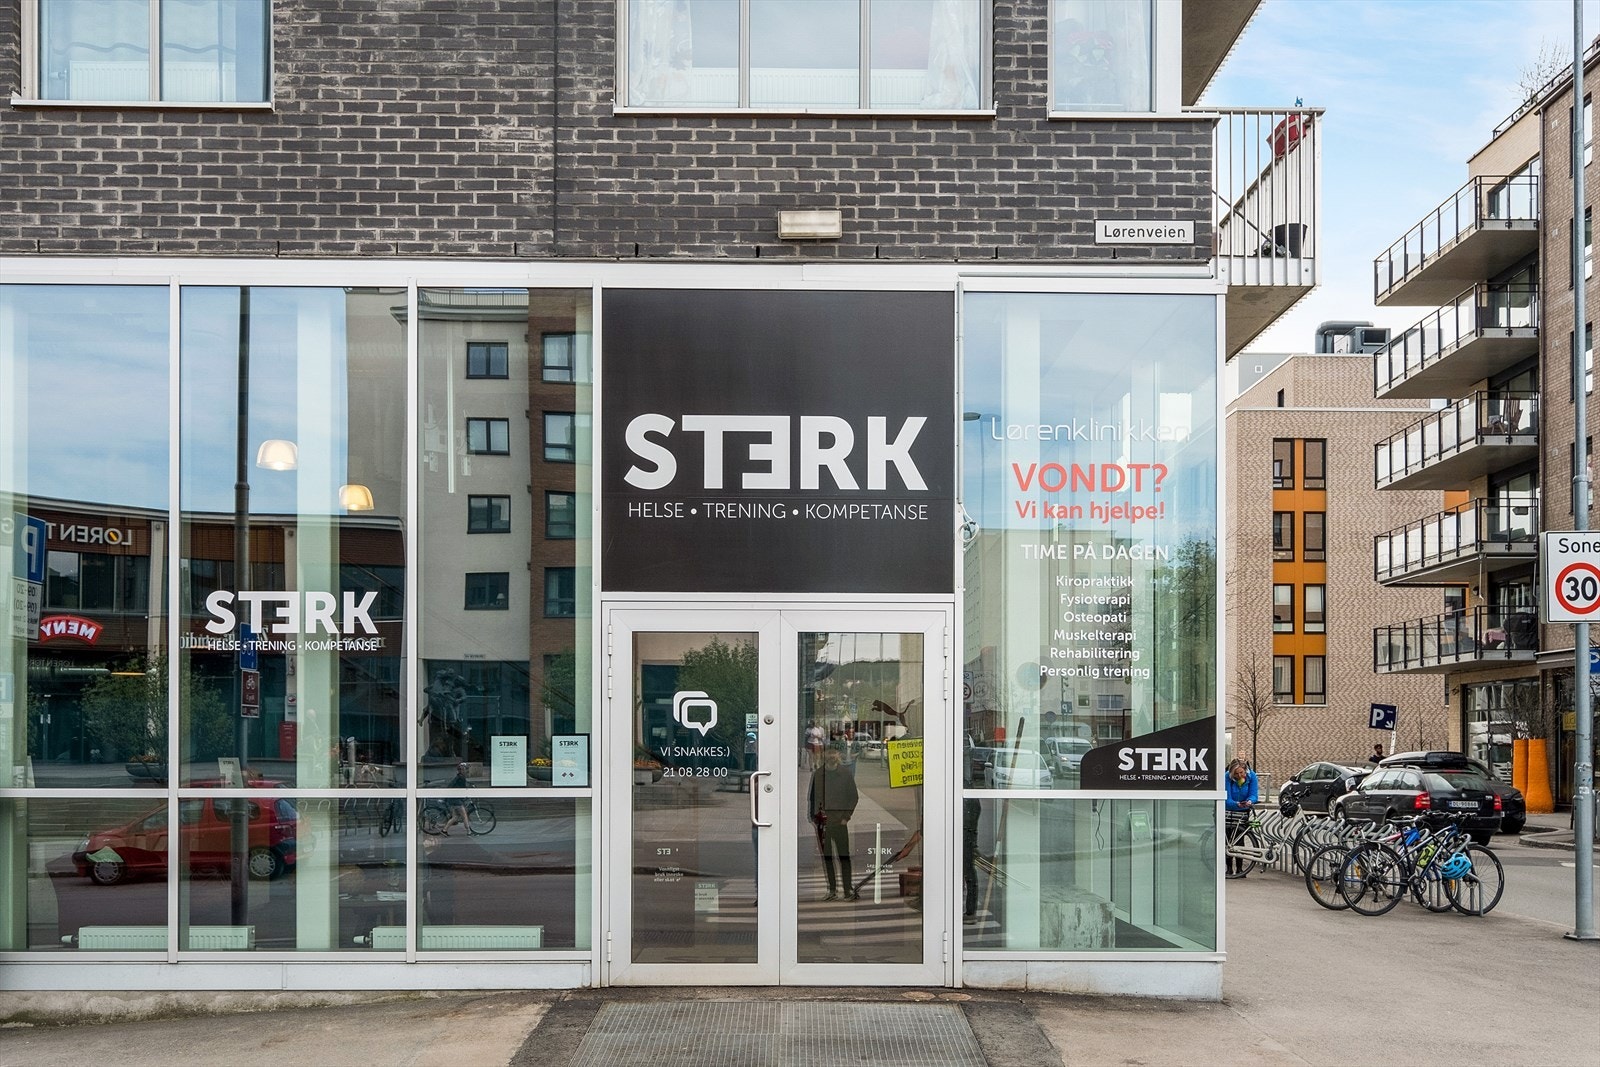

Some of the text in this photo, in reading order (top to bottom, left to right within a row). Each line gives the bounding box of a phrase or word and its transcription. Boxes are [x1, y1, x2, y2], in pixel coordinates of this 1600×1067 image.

[1104, 224, 1186, 238] Lørenveien
[991, 416, 1191, 442] Lørenklinikken
[1011, 463, 1168, 493] VONDT?
[628, 502, 928, 520] HELSE TRENING KOMPETANSE
[1015, 500, 1165, 524] Vi kan hjelpe!
[1020, 541, 1169, 560] TIME PÅ DAGEN
[1056, 575, 1135, 588] Kiropraktikk
[1565, 576, 1598, 602] 30
[1060, 593, 1131, 607] Fysioterapi
[1063, 611, 1127, 625] Osteopati
[1053, 629, 1137, 643] Muskelterapi
[207, 640, 241, 651] HELSE
[250, 640, 296, 651] TRENING
[305, 640, 378, 651] KOMPETANSE
[1050, 647, 1140, 660] Rehabilitering
[1040, 665, 1150, 679] Personlig trening
[1371, 708, 1385, 727] P
[660, 746, 730, 757] VI SNAKKES:)
[663, 767, 728, 777] 21 08 28 00
